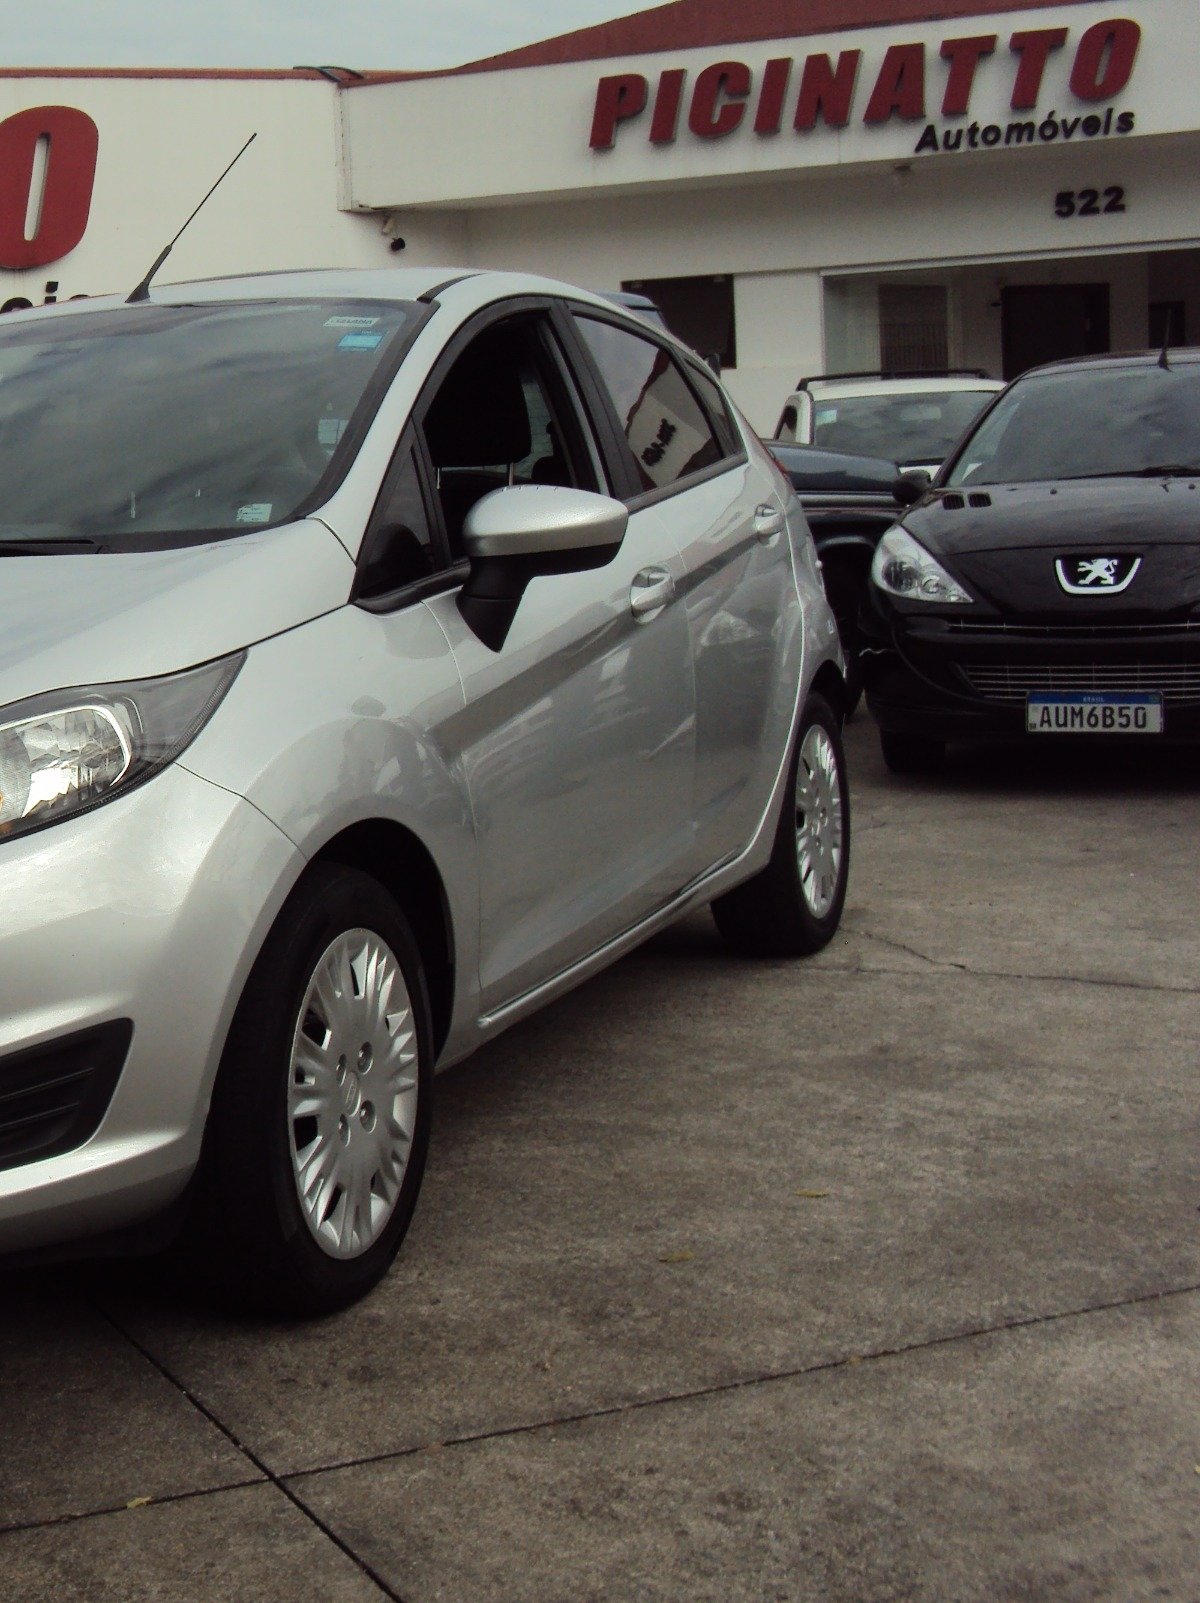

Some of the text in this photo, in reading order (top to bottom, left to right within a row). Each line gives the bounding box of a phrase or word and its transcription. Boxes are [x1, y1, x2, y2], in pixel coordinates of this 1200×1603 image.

[589, 18, 1142, 150] PICINATTO
[914, 107, 1135, 153] Automóveis
[1054, 185, 1126, 218] 522
[1039, 705, 1148, 729] AUM6B50
